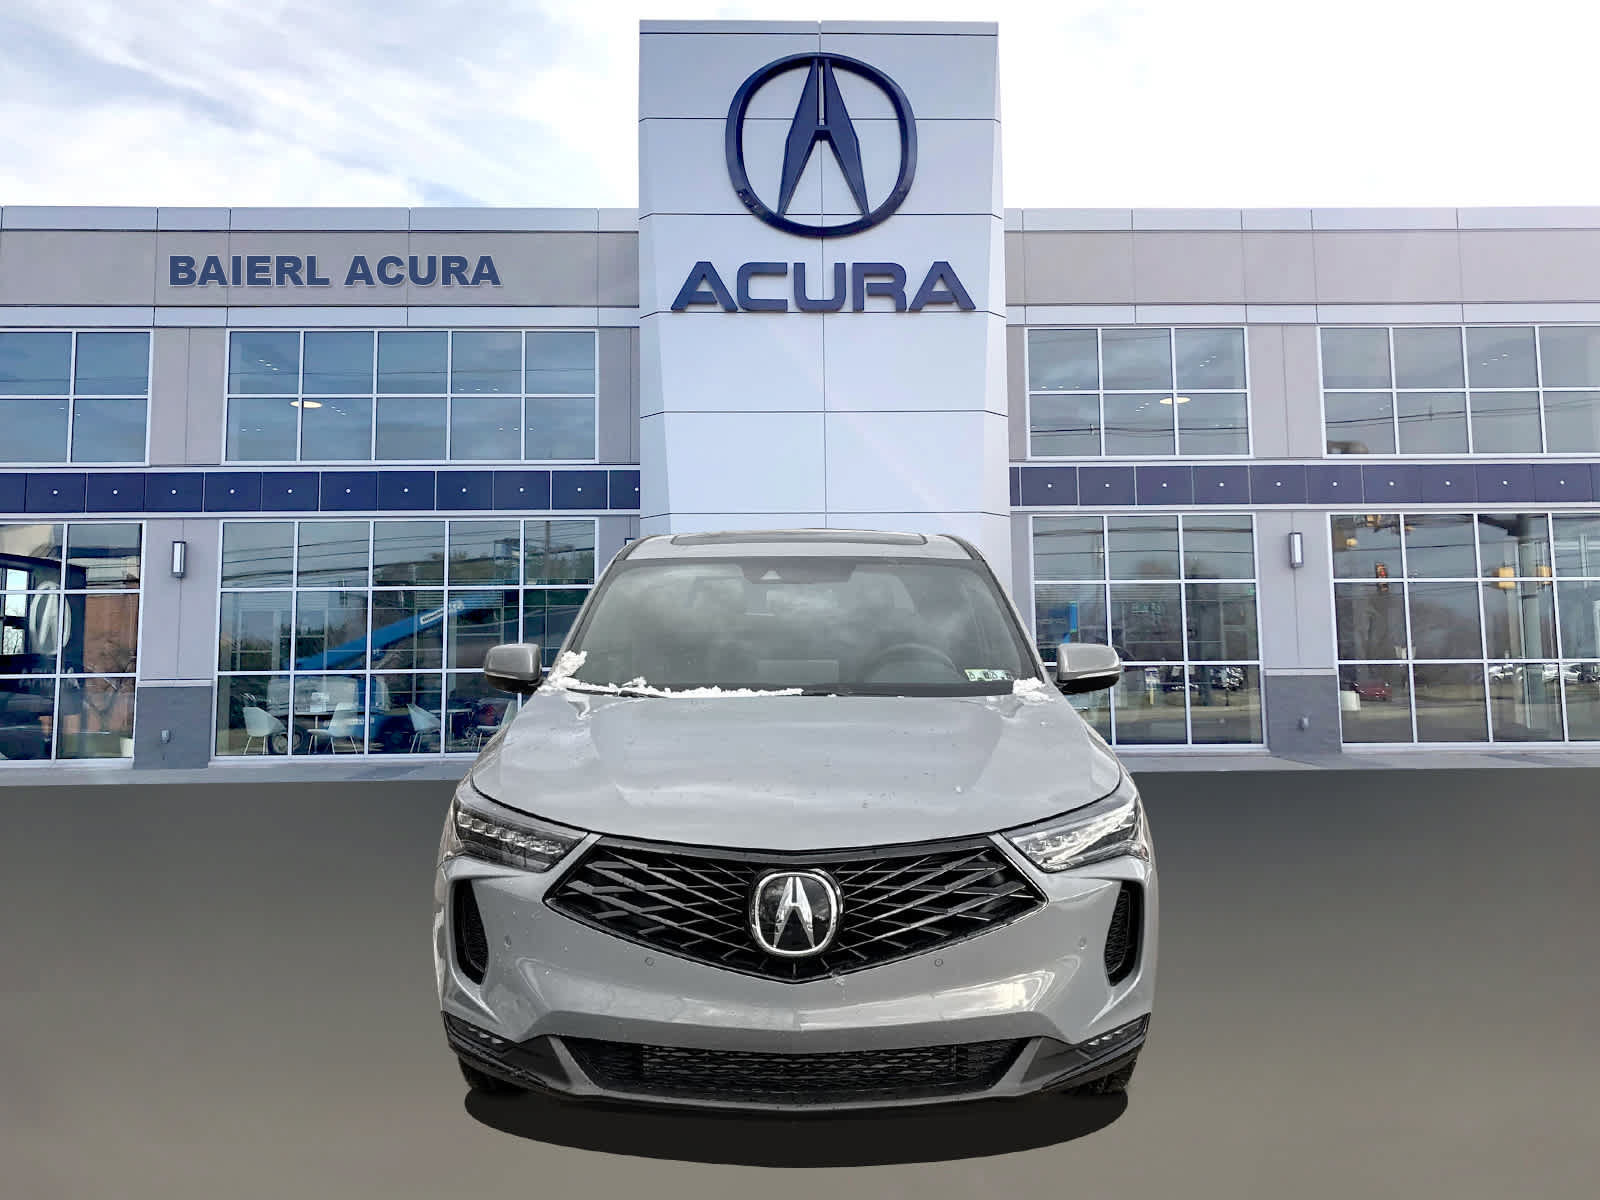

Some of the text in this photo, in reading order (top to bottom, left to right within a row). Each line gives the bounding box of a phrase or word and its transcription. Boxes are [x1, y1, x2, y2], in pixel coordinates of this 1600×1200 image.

[170, 256, 501, 288] BAIERL ACURA
[671, 261, 976, 312] ACURA
